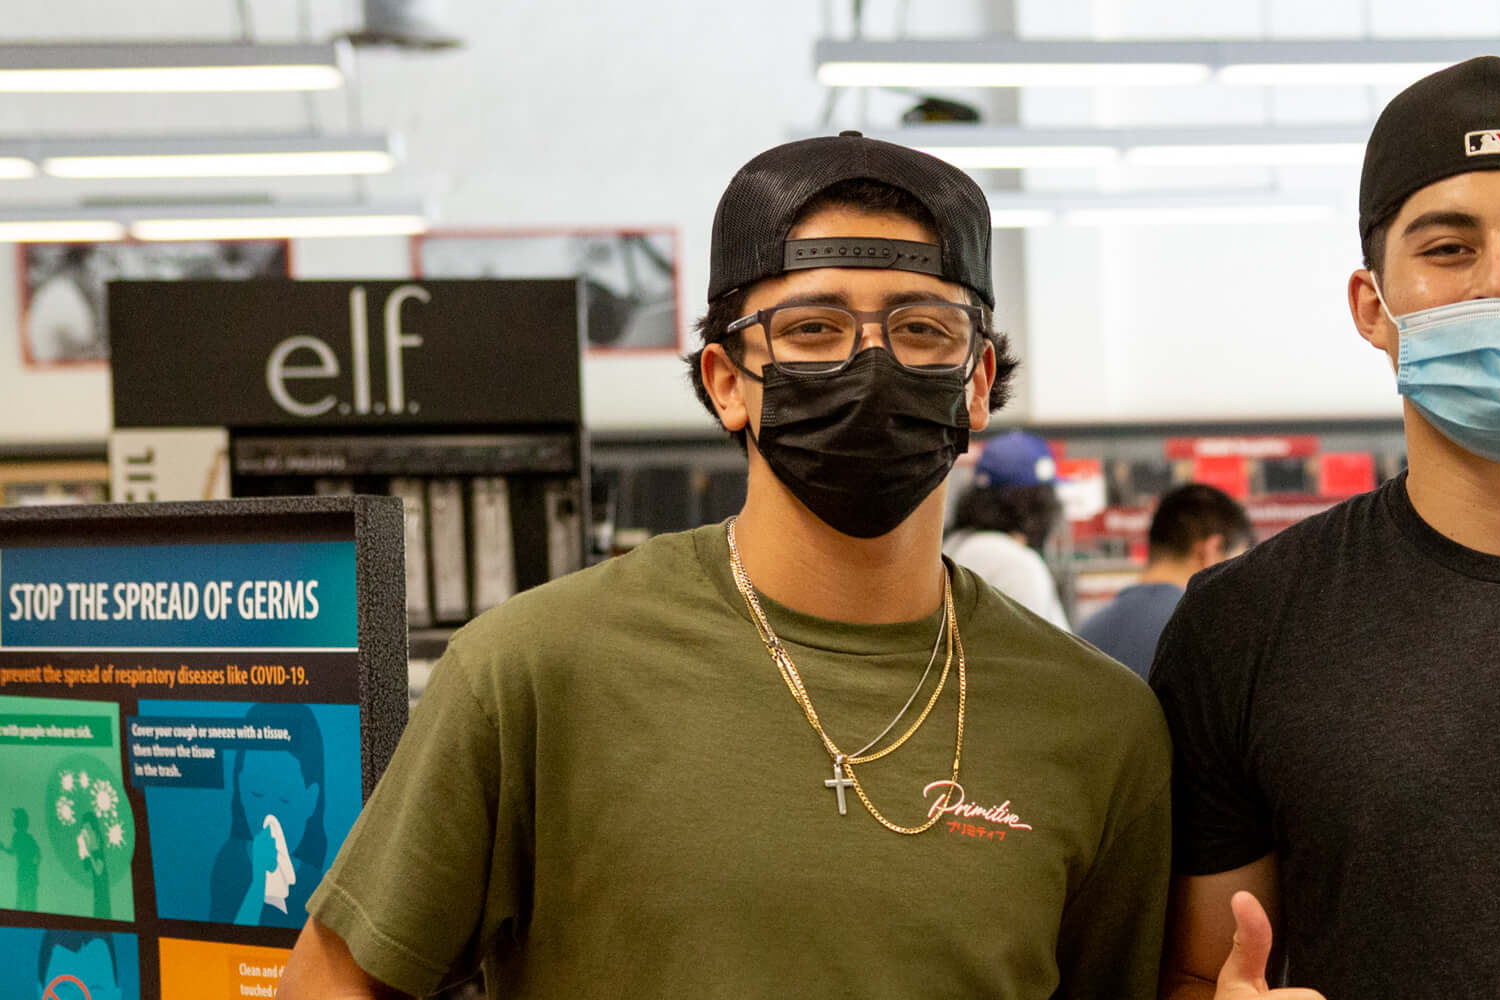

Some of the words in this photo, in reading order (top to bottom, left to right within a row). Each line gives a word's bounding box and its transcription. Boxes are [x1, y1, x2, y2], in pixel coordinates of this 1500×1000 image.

[9, 582, 64, 621] STOP
[66, 582, 109, 621] THE
[112, 581, 199, 621] SPREAD
[203, 580, 233, 620] OF
[237, 579, 319, 620] GERMS
[43, 664, 62, 683] the
[63, 664, 100, 688] spread
[101, 664, 114, 683] of
[115, 664, 176, 688] respiratory
[177, 664, 225, 685] diseases
[226, 664, 248, 685] like
[250, 664, 309, 685] COVID-19.
[131, 723, 153, 738] Cover
[154, 726, 173, 740] your
[173, 724, 197, 741] cough
[198, 727, 207, 738] or
[207, 727, 236, 739] sneeze
[236, 725, 256, 739] with
[256, 727, 263, 739] a
[263, 725, 292, 742] tissue,
[132, 743, 152, 757] then
[152, 743, 176, 758] throw
[176, 744, 191, 758] the
[191, 744, 216, 759] tissue
[143, 763, 158, 777] the
[922, 779, 1033, 832] Primitive
[239, 962, 262, 977] Clean
[262, 964, 278, 979] and
[240, 983, 273, 998] touched
